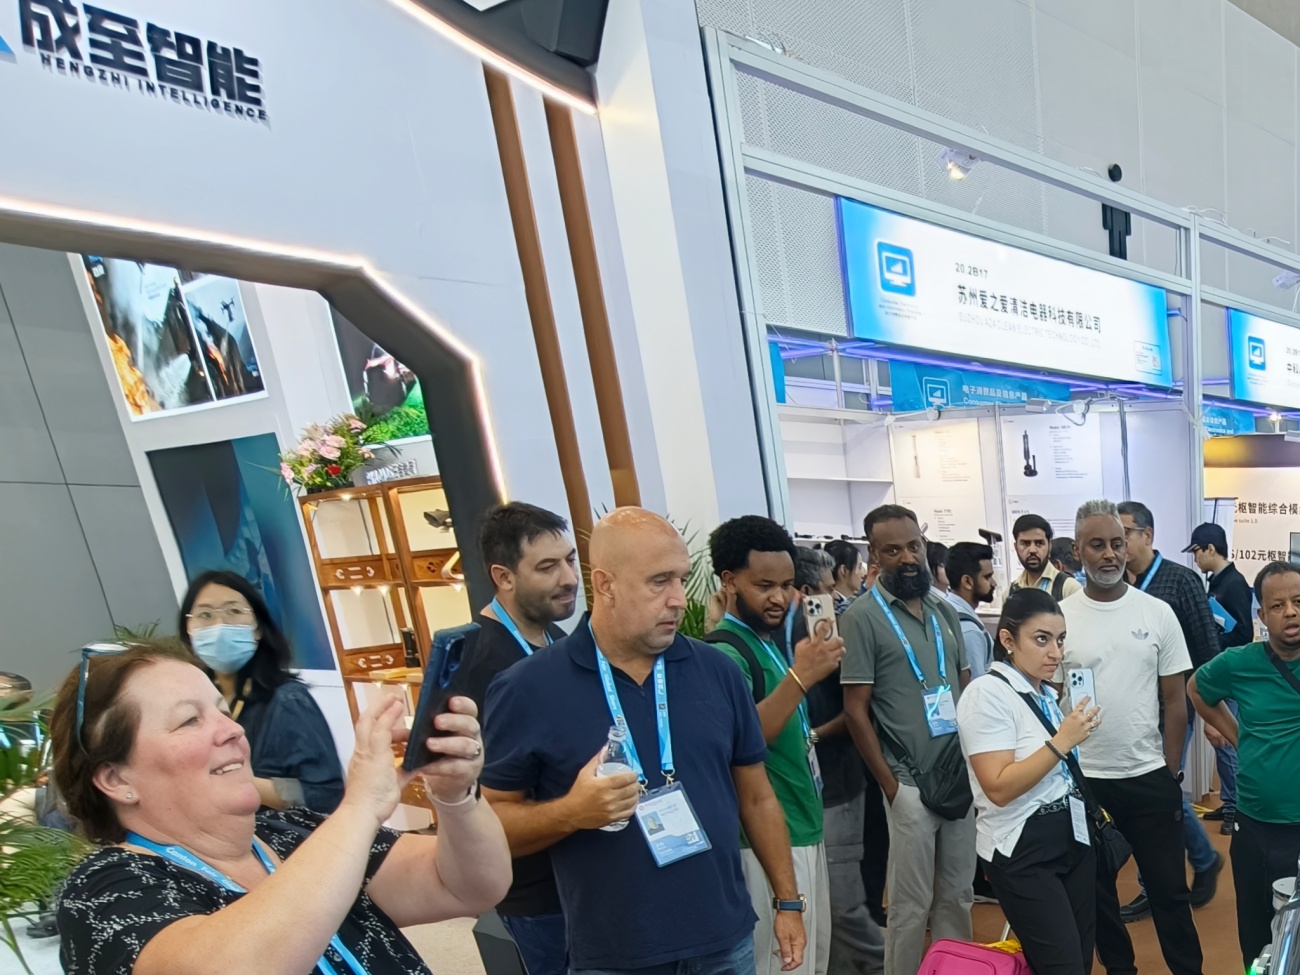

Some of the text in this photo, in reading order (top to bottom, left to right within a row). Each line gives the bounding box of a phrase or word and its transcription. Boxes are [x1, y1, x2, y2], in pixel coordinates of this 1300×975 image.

[19, 0, 263, 107] 成至智能
[40, 52, 267, 120] HENGZHI INTELLIGENCE
[166, 847, 198, 867] Canton
